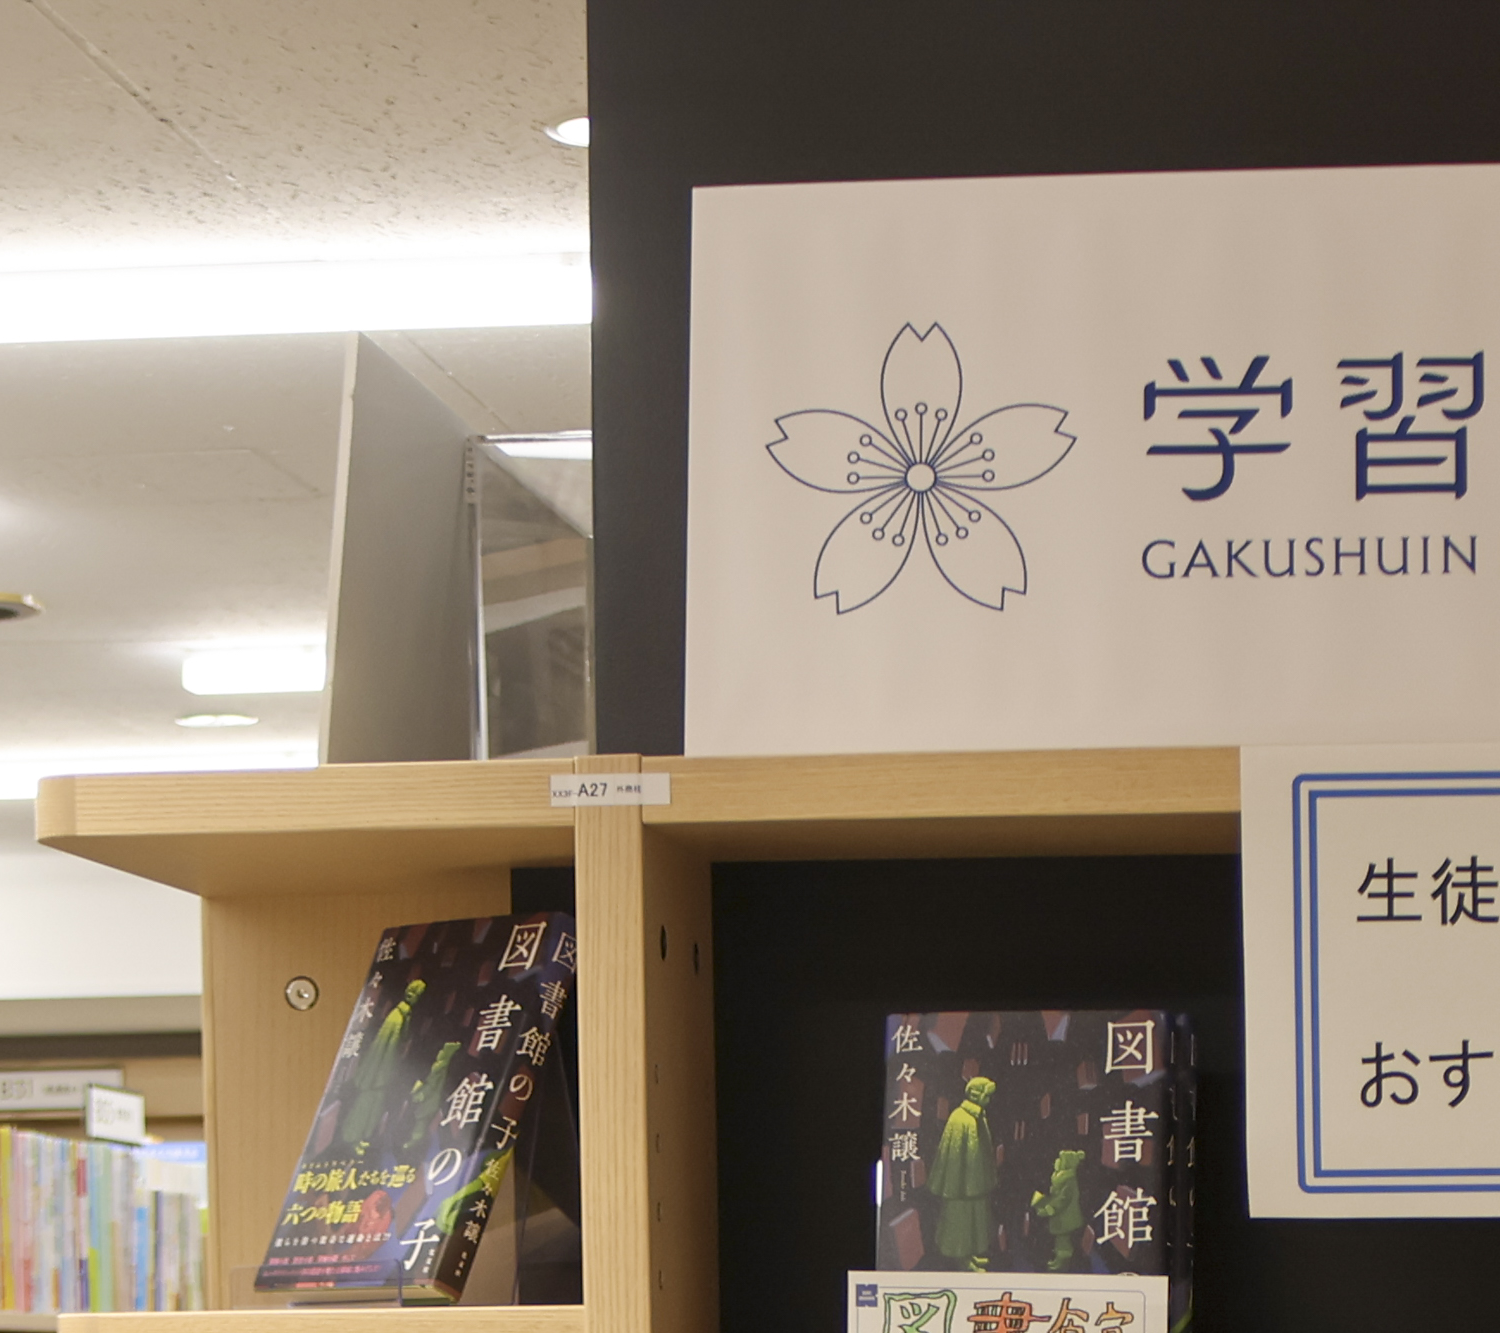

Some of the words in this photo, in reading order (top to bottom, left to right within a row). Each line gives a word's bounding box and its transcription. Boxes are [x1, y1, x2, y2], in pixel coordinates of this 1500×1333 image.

[1141, 534, 1479, 580] GAKUSHUIN
[399, 921, 548, 1270] 図書館の子
[888, 1024, 924, 1163] 佐々木譲
[293, 1165, 416, 1194] 時の旅人たちを巡る
[1094, 1020, 1159, 1275] 図書館
[281, 1200, 364, 1226] 六つの物語
